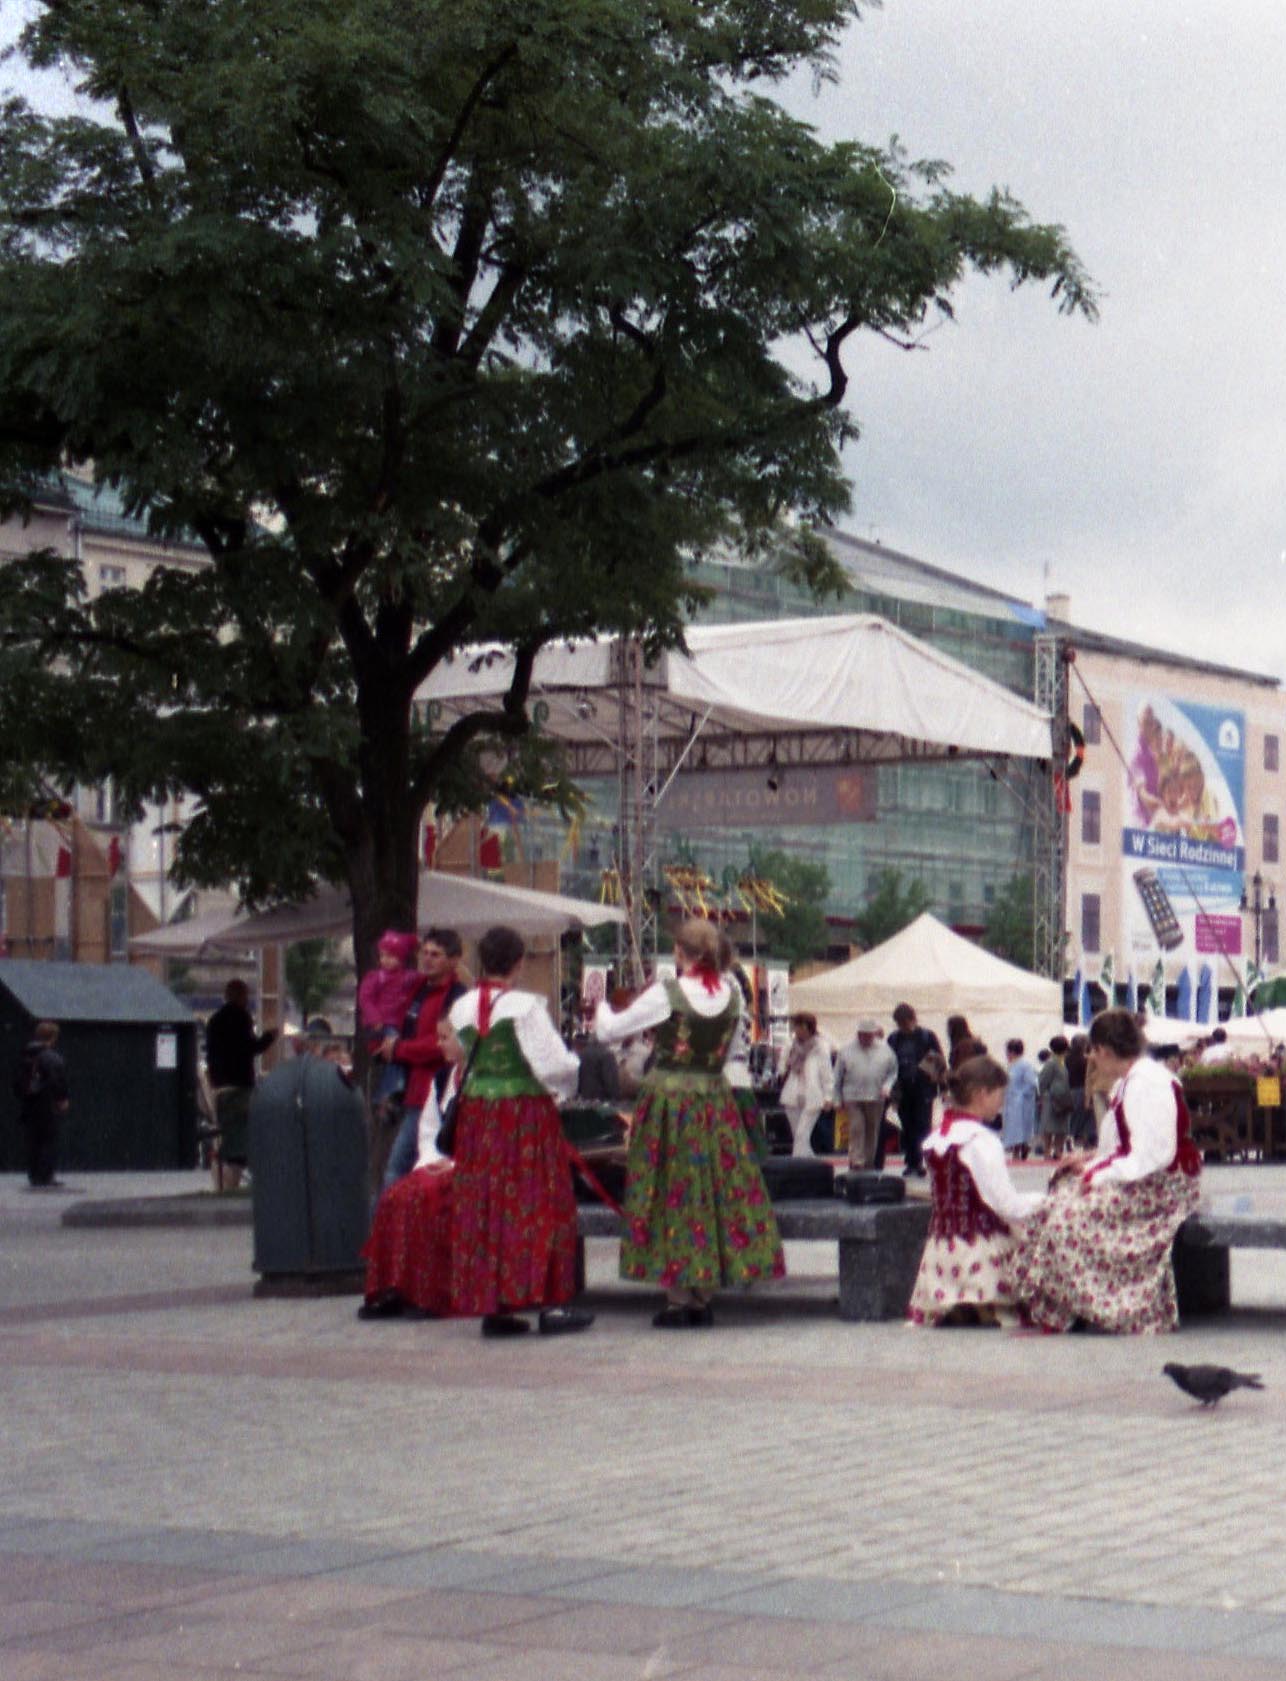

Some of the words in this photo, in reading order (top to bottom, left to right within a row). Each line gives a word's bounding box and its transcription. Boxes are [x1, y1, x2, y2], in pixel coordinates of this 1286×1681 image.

[1132, 833, 1145, 853] W
[1148, 836, 1177, 857] Sieci
[1180, 842, 1237, 871] Rodzinnej
